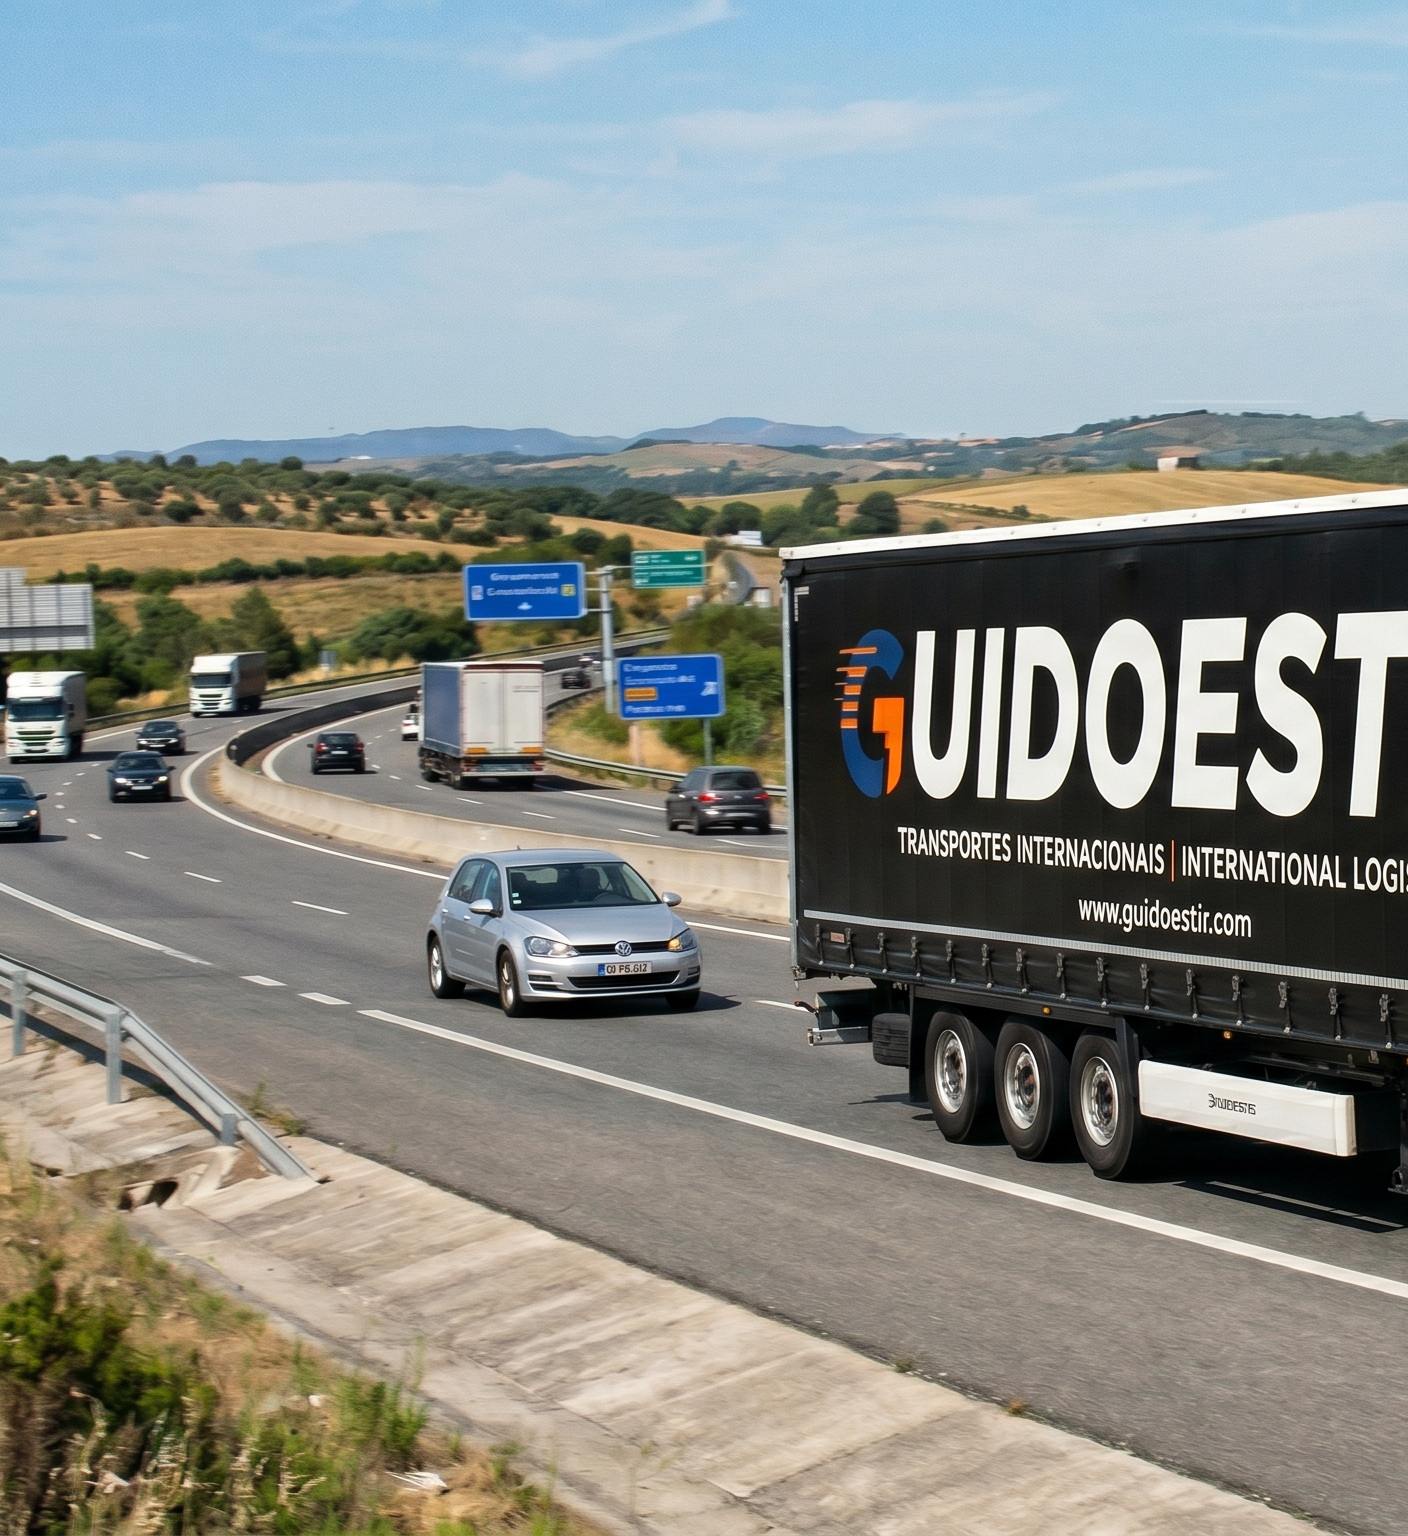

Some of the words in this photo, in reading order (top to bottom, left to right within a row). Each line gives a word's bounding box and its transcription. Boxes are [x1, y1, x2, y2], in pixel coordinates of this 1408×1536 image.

[897, 826, 1012, 863] TRANSPORTES
[1016, 834, 1165, 875] INTERNACIONAIS
[1182, 845, 1347, 889] INTERNATIONAL
[1078, 898, 1252, 938] www.guidoestir.com
